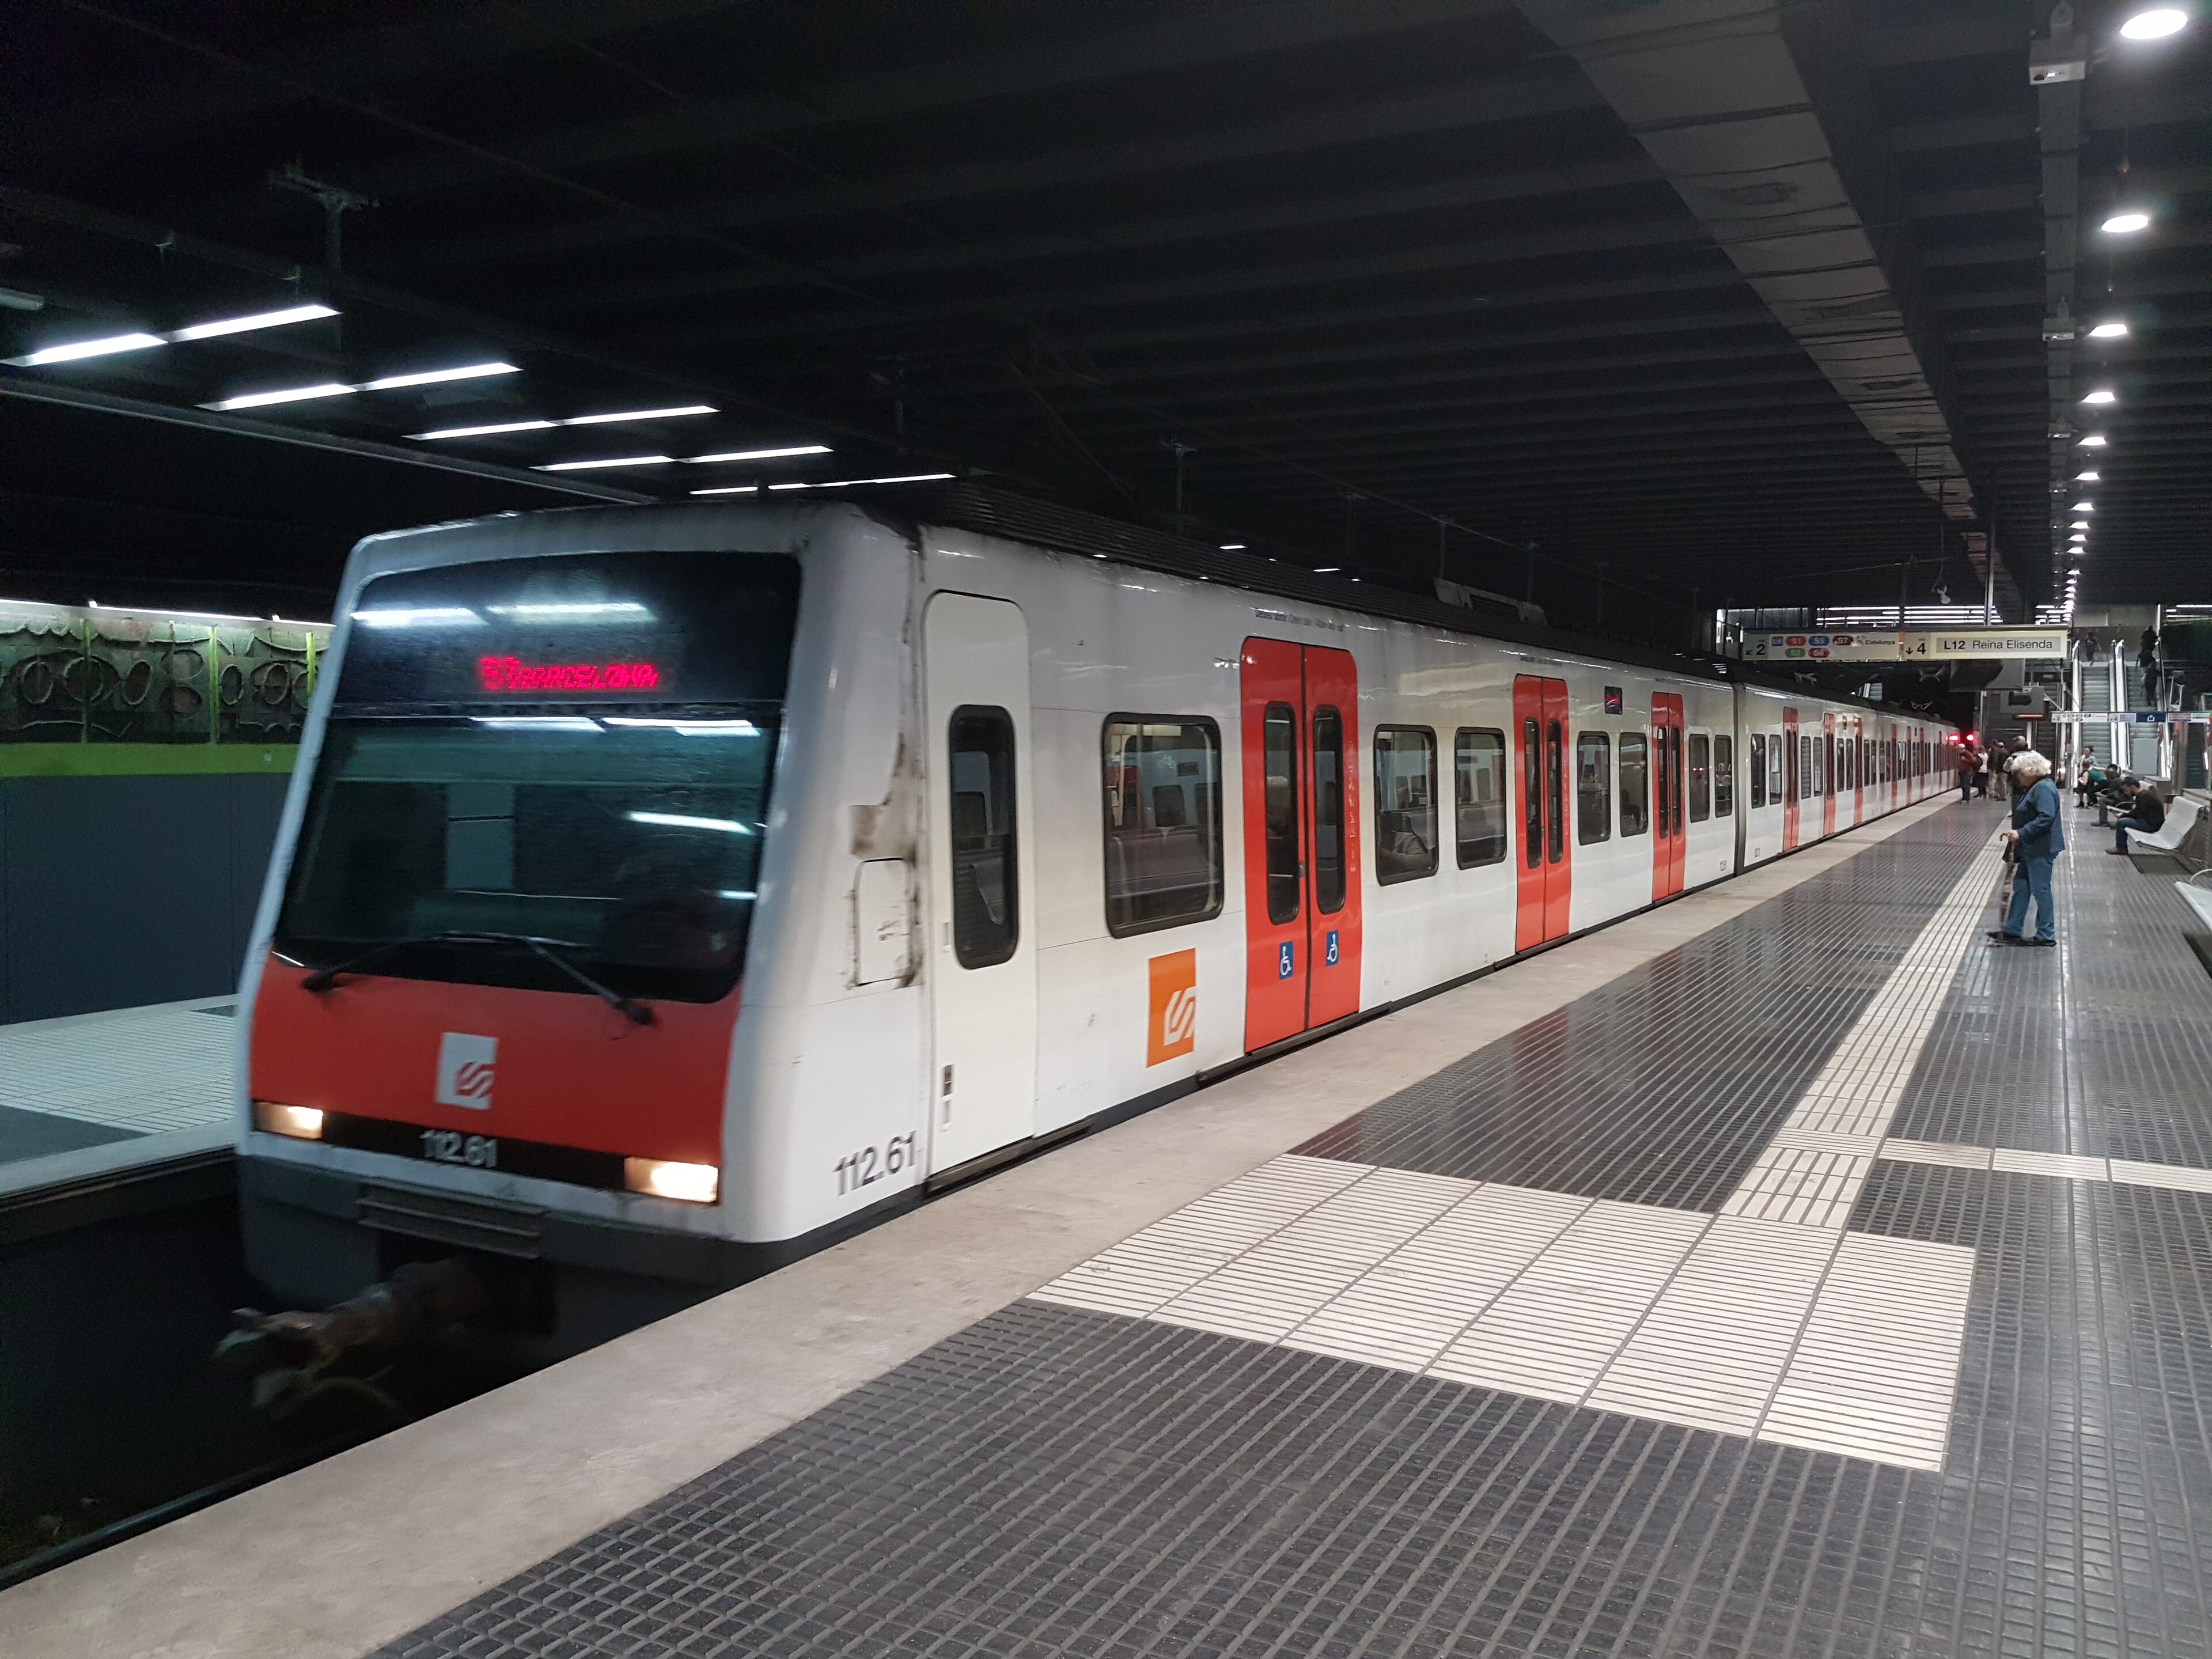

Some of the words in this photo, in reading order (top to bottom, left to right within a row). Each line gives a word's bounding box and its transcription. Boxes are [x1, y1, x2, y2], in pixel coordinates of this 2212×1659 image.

[1756, 643, 1766, 656] 2
[1916, 642, 1926, 654] 4
[1944, 641, 1965, 650] L12
[1972, 641, 2003, 649] Reina
[2007, 640, 2052, 649] Elisenda
[514, 665, 658, 689] BARCELONA
[832, 1130, 916, 1196] 112.61
